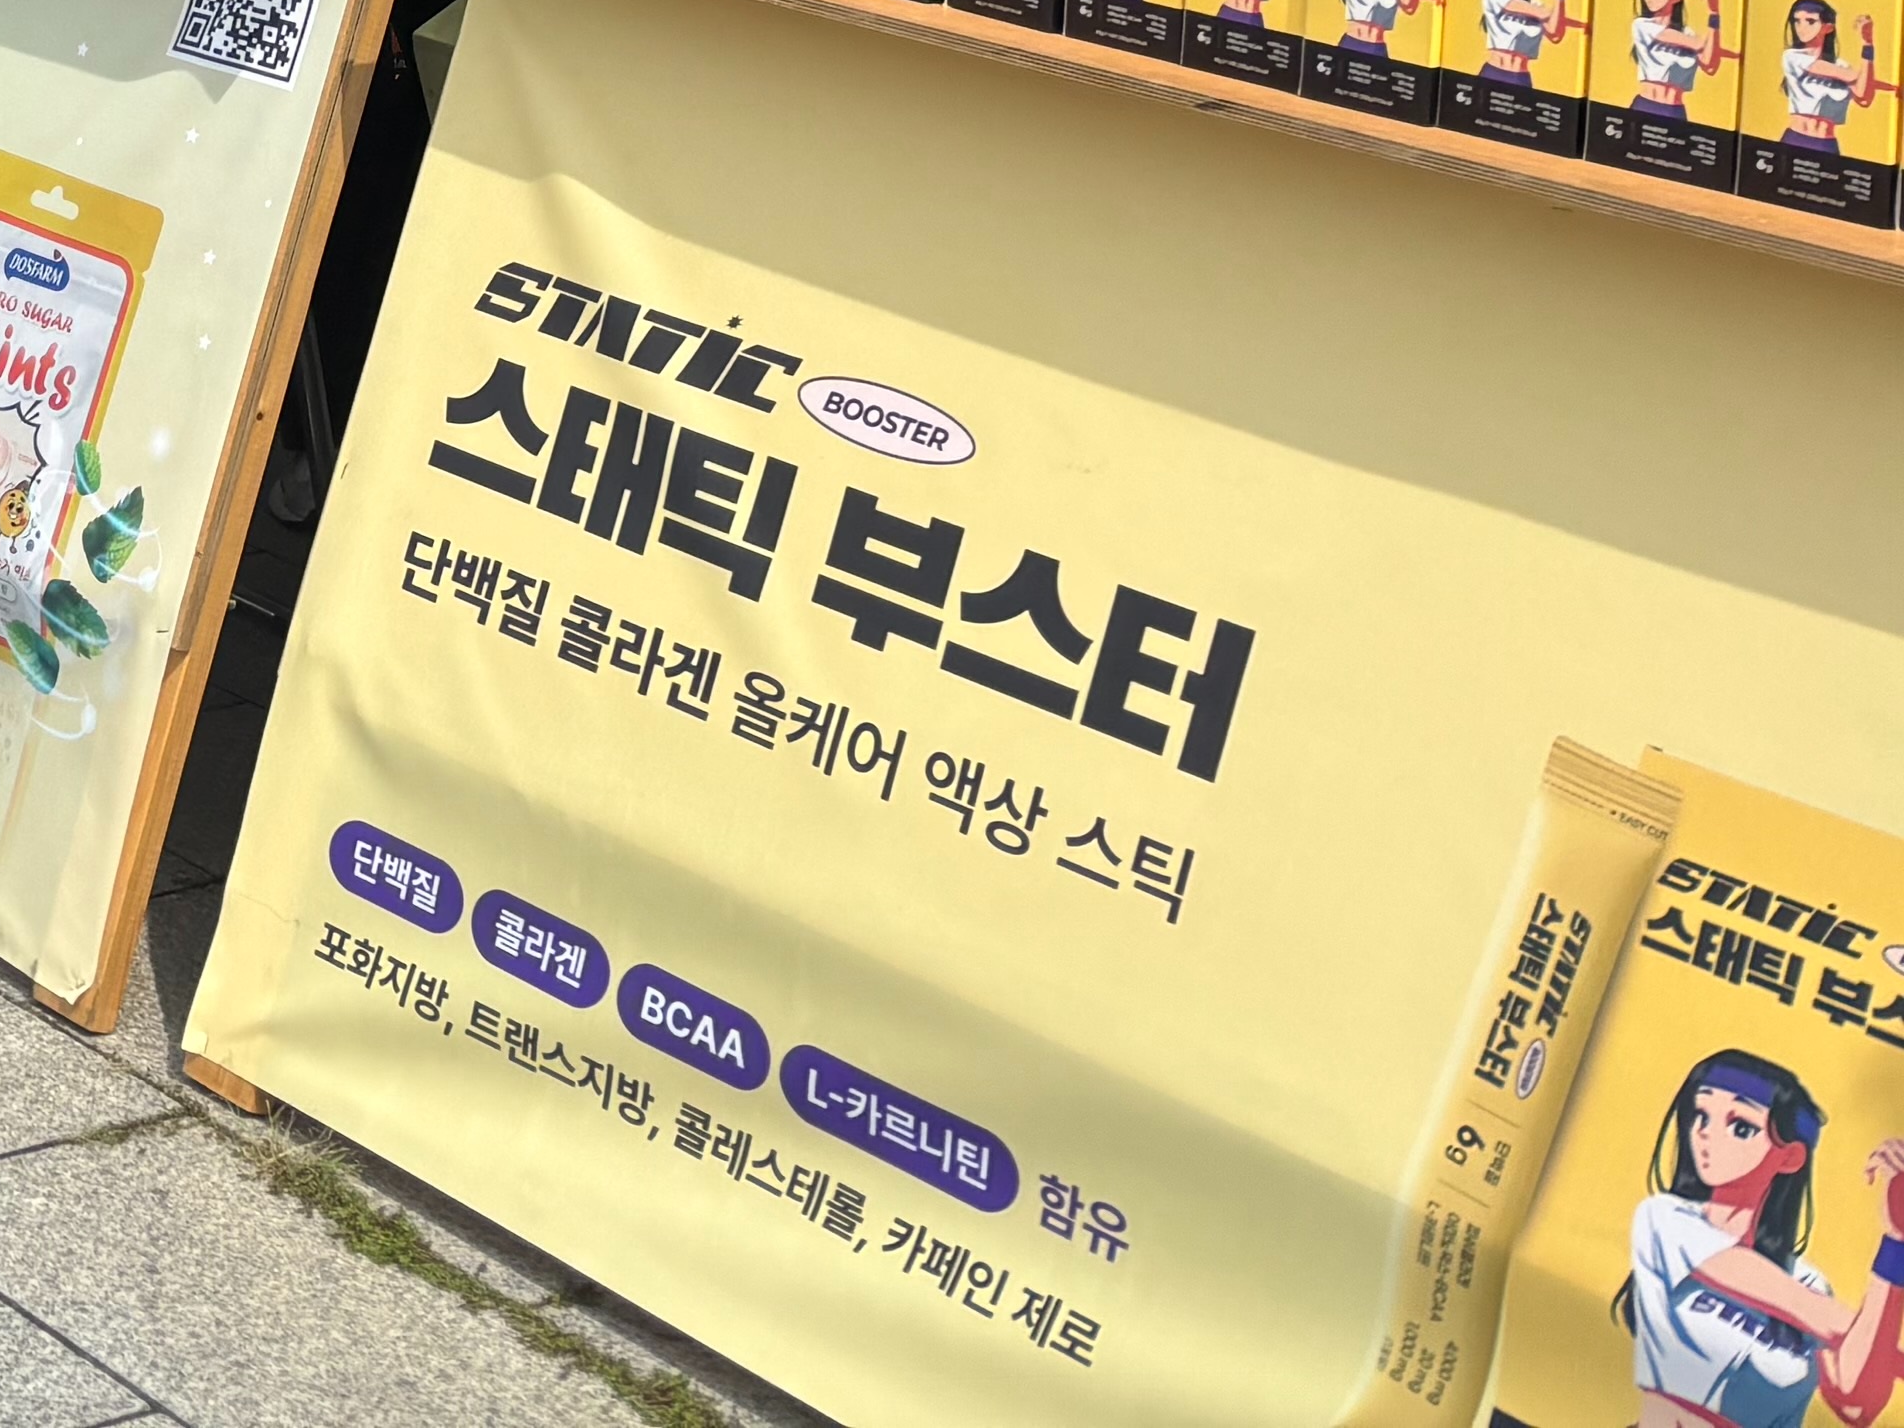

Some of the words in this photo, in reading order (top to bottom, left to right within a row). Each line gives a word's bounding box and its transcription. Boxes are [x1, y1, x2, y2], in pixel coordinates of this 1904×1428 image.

[21, 300, 74, 333] SUGAR
[473, 260, 804, 413] STATIC
[822, 389, 951, 453] BOOSTER
[427, 356, 800, 602] 스태틱
[810, 485, 1257, 784] 부스터
[400, 529, 553, 647] 단백질
[556, 594, 722, 722] 콜라겐
[732, 669, 909, 802] 올케어
[924, 748, 1049, 857] 액상
[1055, 815, 1198, 926] 스틱
[1507, 892, 1566, 993] 스태틱
[1640, 906, 1805, 1007] 스태틱
[1657, 858, 1879, 960] STATIC
[351, 838, 444, 914] 단백질
[492, 905, 589, 990] 콜라겐
[638, 984, 747, 1071] BCAA
[805, 1066, 991, 1193] L-카르니틴
[1036, 1171, 1133, 1263] 함유
[1473, 990, 1534, 1089] 부스터
[313, 920, 456, 1035] 포화지방,
[463, 999, 662, 1141] 트랜스지방,
[672, 1099, 872, 1253] 콜레스테롤,
[880, 1214, 1013, 1320] 카페인
[1008, 1281, 1106, 1369] 제로
[1444, 1124, 1486, 1167] 6g
